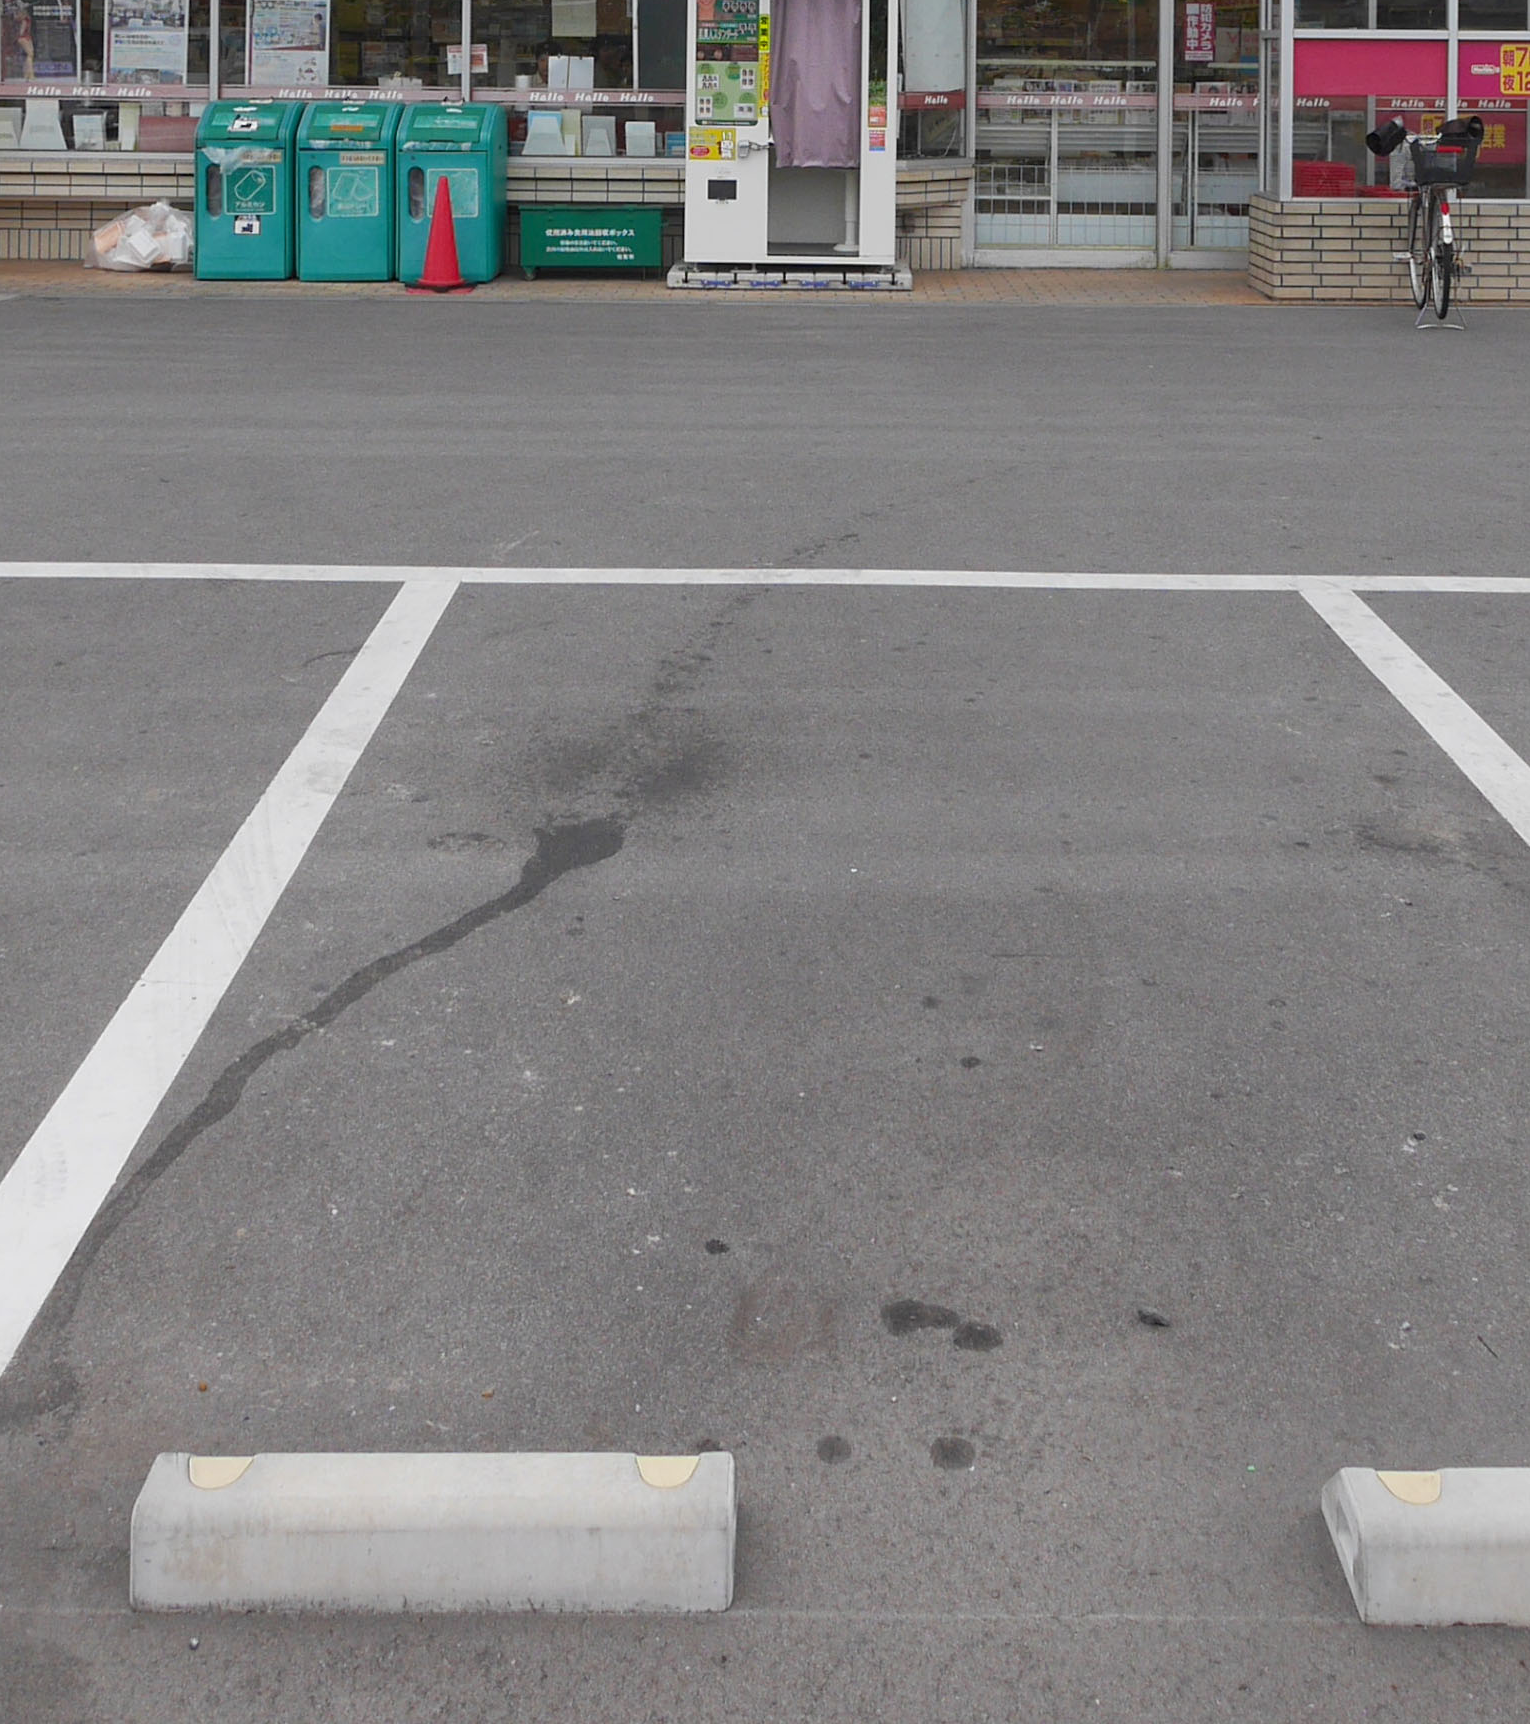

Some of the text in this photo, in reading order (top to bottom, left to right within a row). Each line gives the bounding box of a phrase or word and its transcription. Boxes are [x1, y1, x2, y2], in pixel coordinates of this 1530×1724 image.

[1200, 3, 1213, 51] 防犯カメラ
[26, 86, 152, 97] Hallo Hallo Hallo
[278, 89, 403, 100] Hallo Hallo Hallo
[529, 92, 654, 102] Hallo Hallo Hallo
[924, 95, 948, 105] Hallo
[1006, 95, 1127, 105] Hallo Hallo Hallo
[1209, 97, 1243, 107] Hallo
[1296, 97, 1330, 107] Hallo
[1391, 99, 1425, 108] Hallo
[1477, 99, 1511, 108] Hallo
